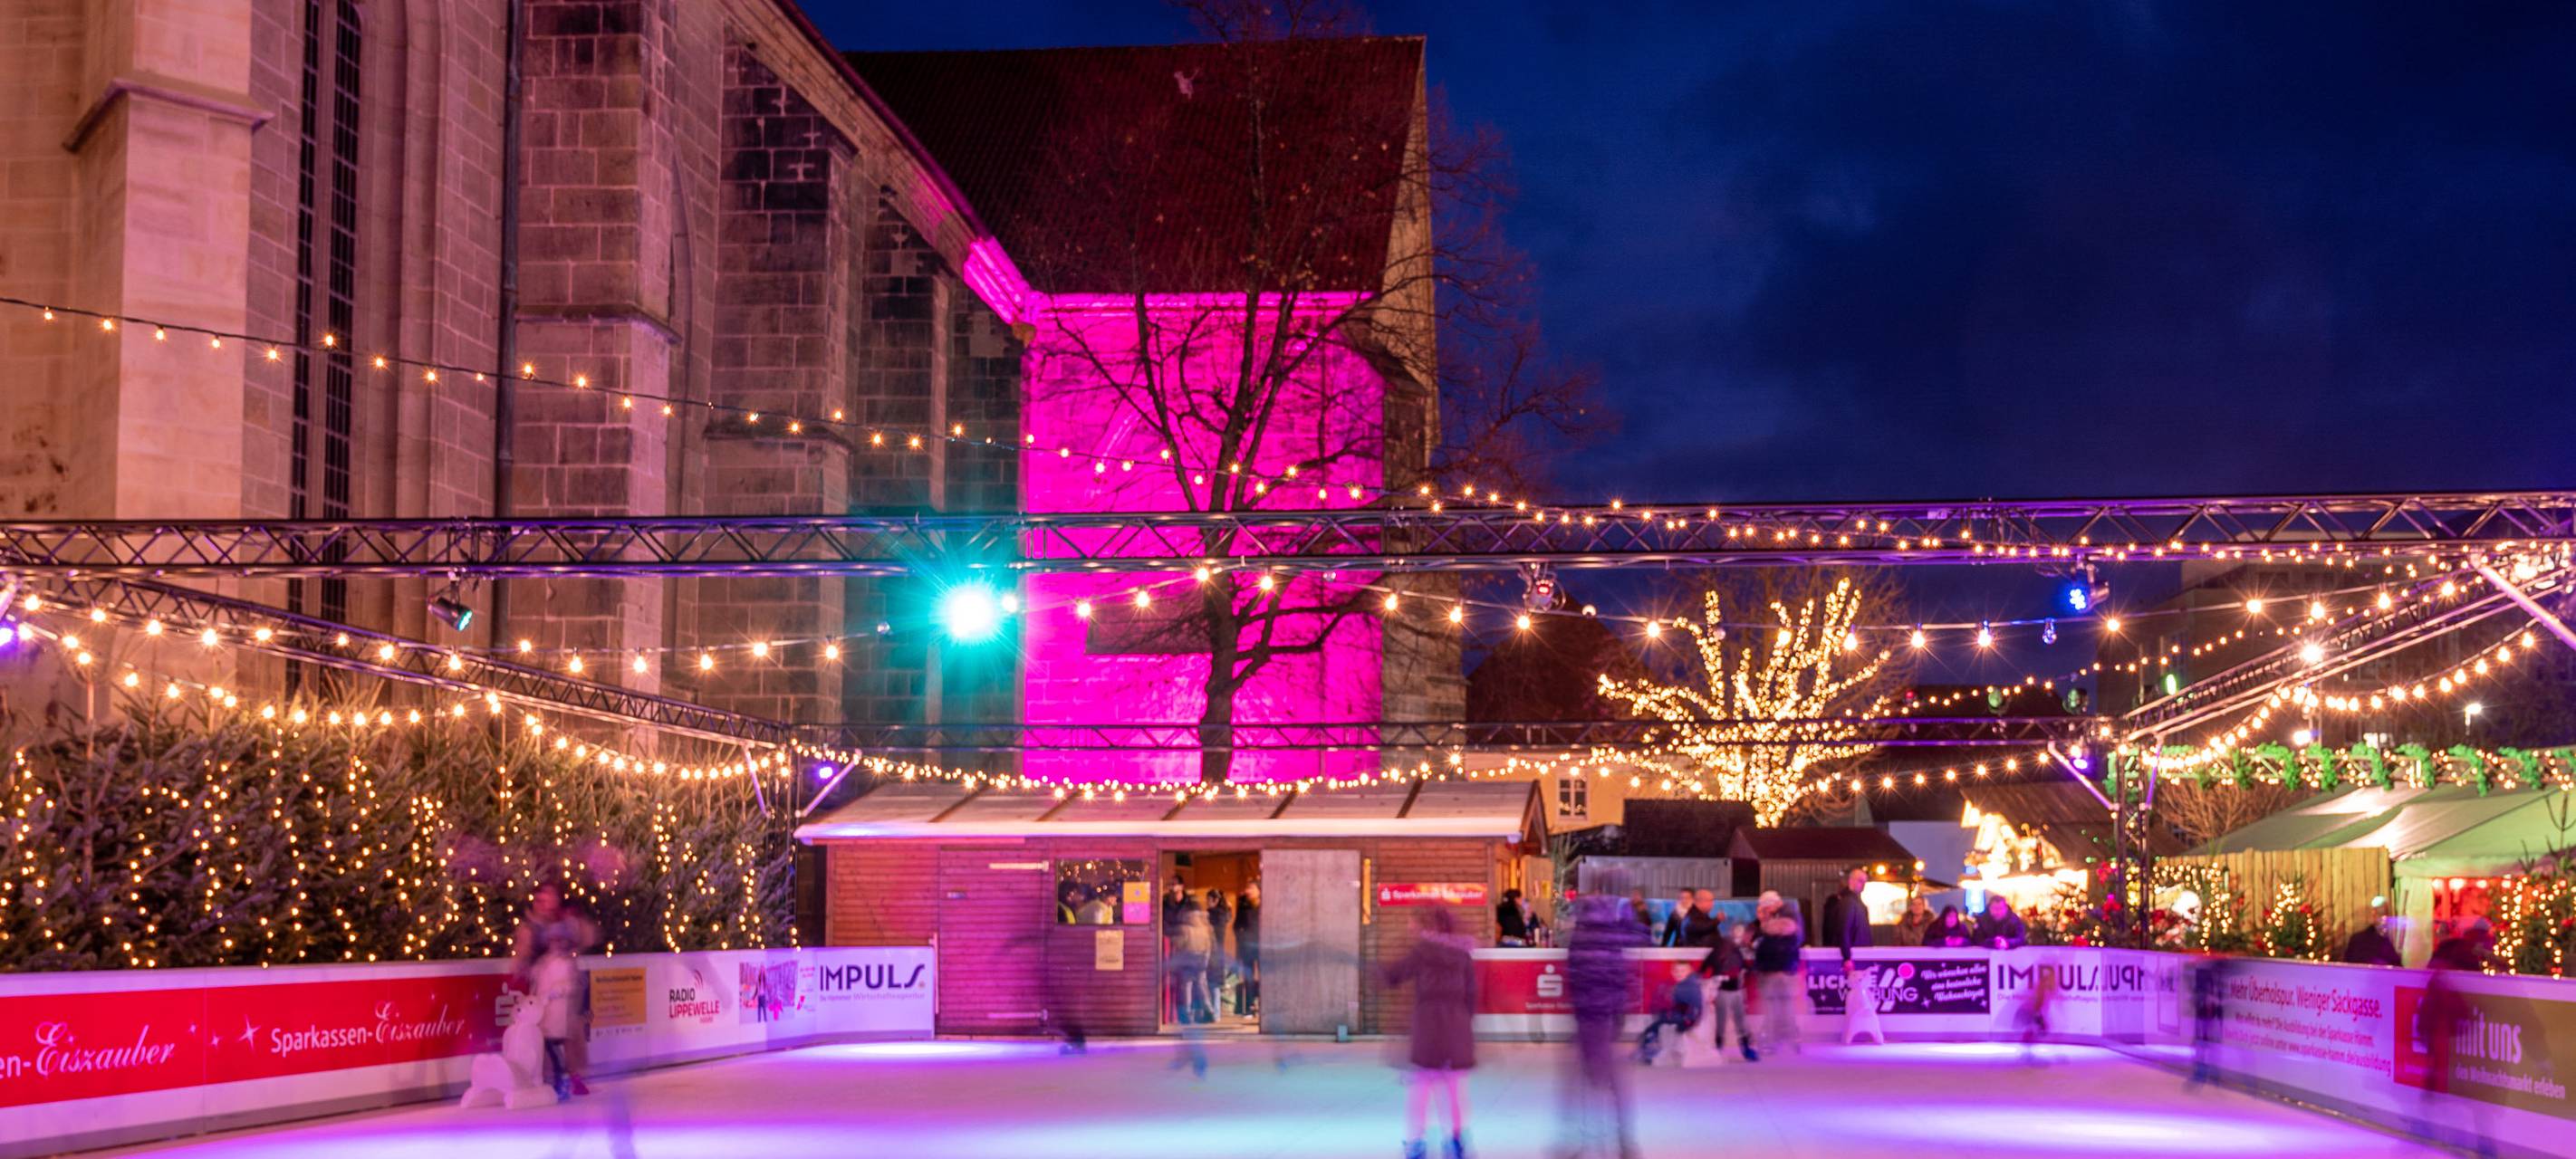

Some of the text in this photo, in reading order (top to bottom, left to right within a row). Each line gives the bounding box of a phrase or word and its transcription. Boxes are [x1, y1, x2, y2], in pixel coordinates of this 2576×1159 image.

[669, 988, 696, 1002] RADIO
[2296, 984, 2330, 1017] Weniger
[2331, 988, 2383, 1022] Sackgasse.
[669, 1001, 720, 1019] LIPPEWELLE
[2456, 1005, 2523, 1064] mit uns
[2533, 1077, 2566, 1099] erleben
